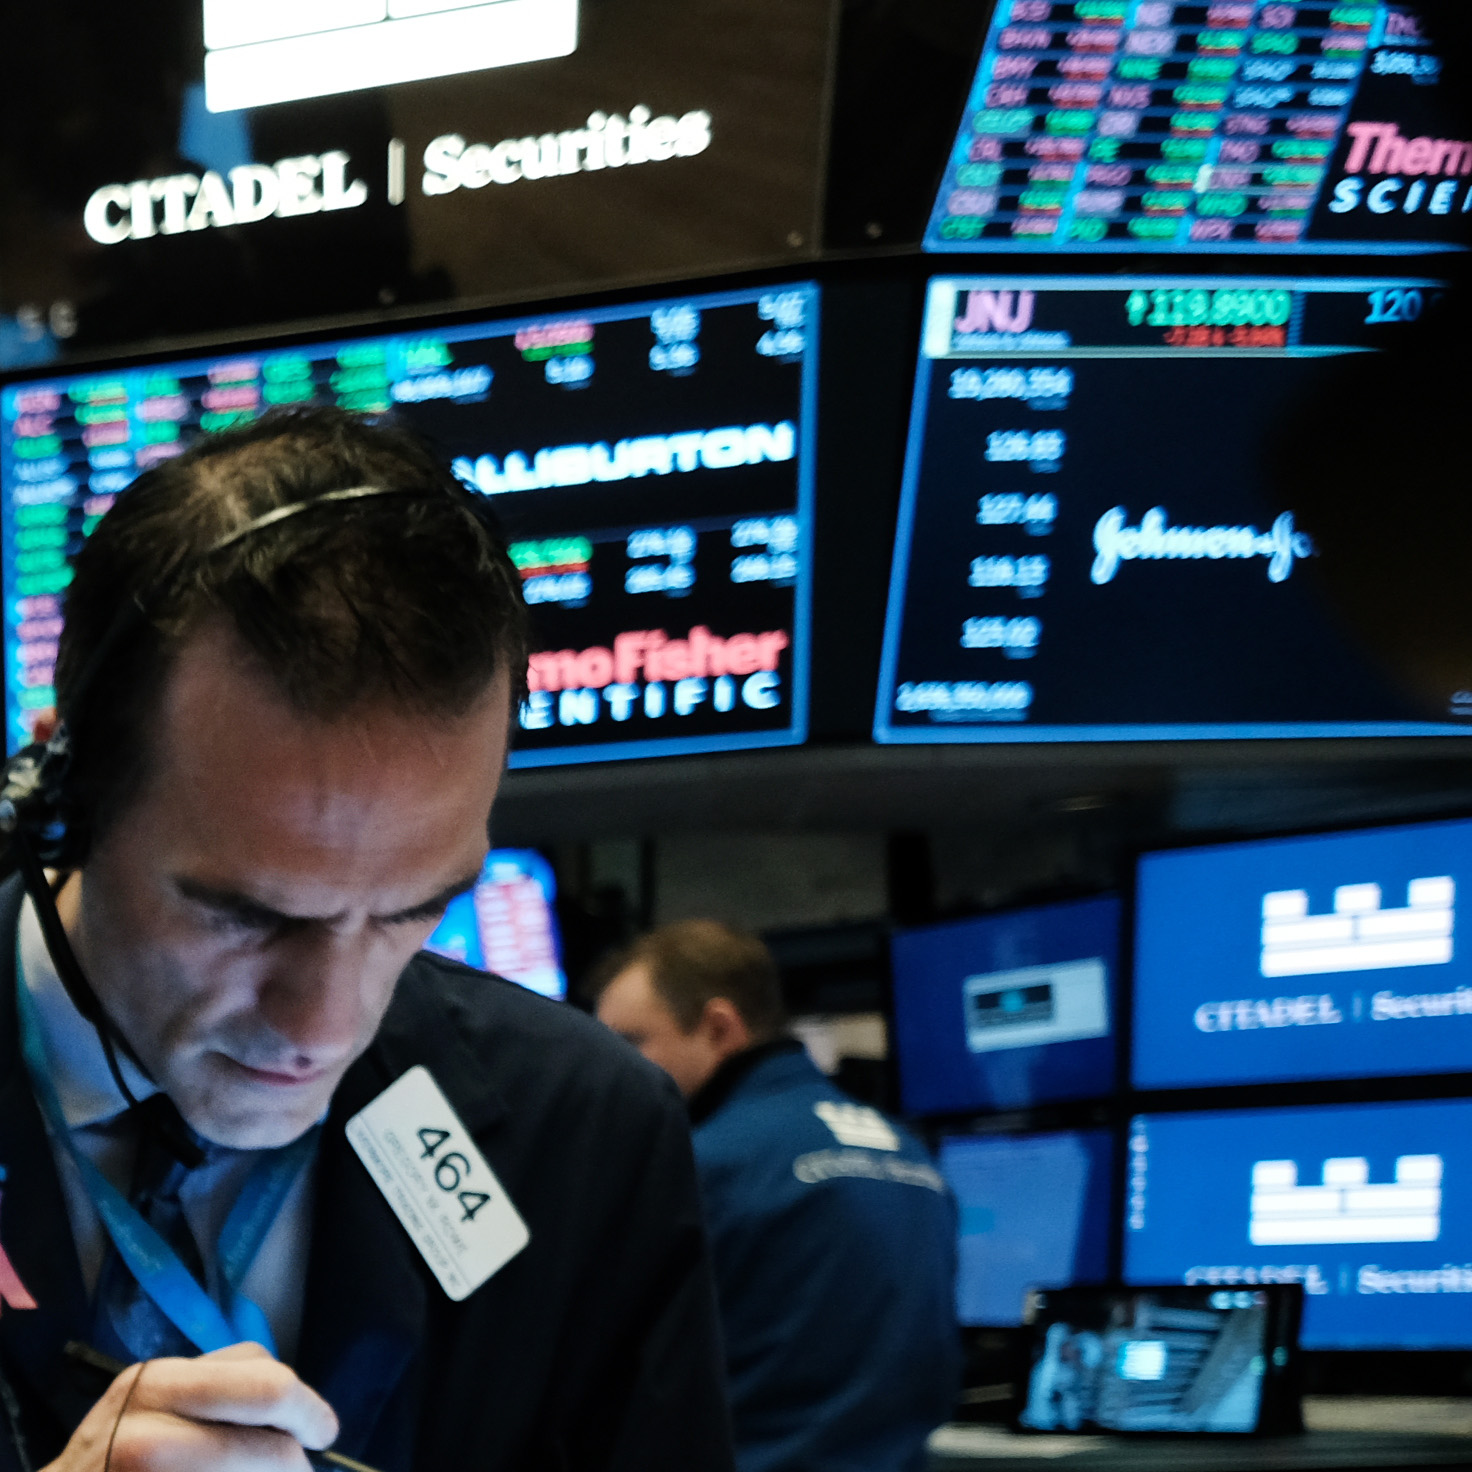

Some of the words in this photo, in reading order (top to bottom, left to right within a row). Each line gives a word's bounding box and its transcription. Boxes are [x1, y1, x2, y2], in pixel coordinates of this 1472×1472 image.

[83, 151, 366, 244] CITADEL
[423, 104, 712, 196] Securities
[1194, 992, 1342, 1033] CITADEL
[416, 1127, 491, 1223] 464
